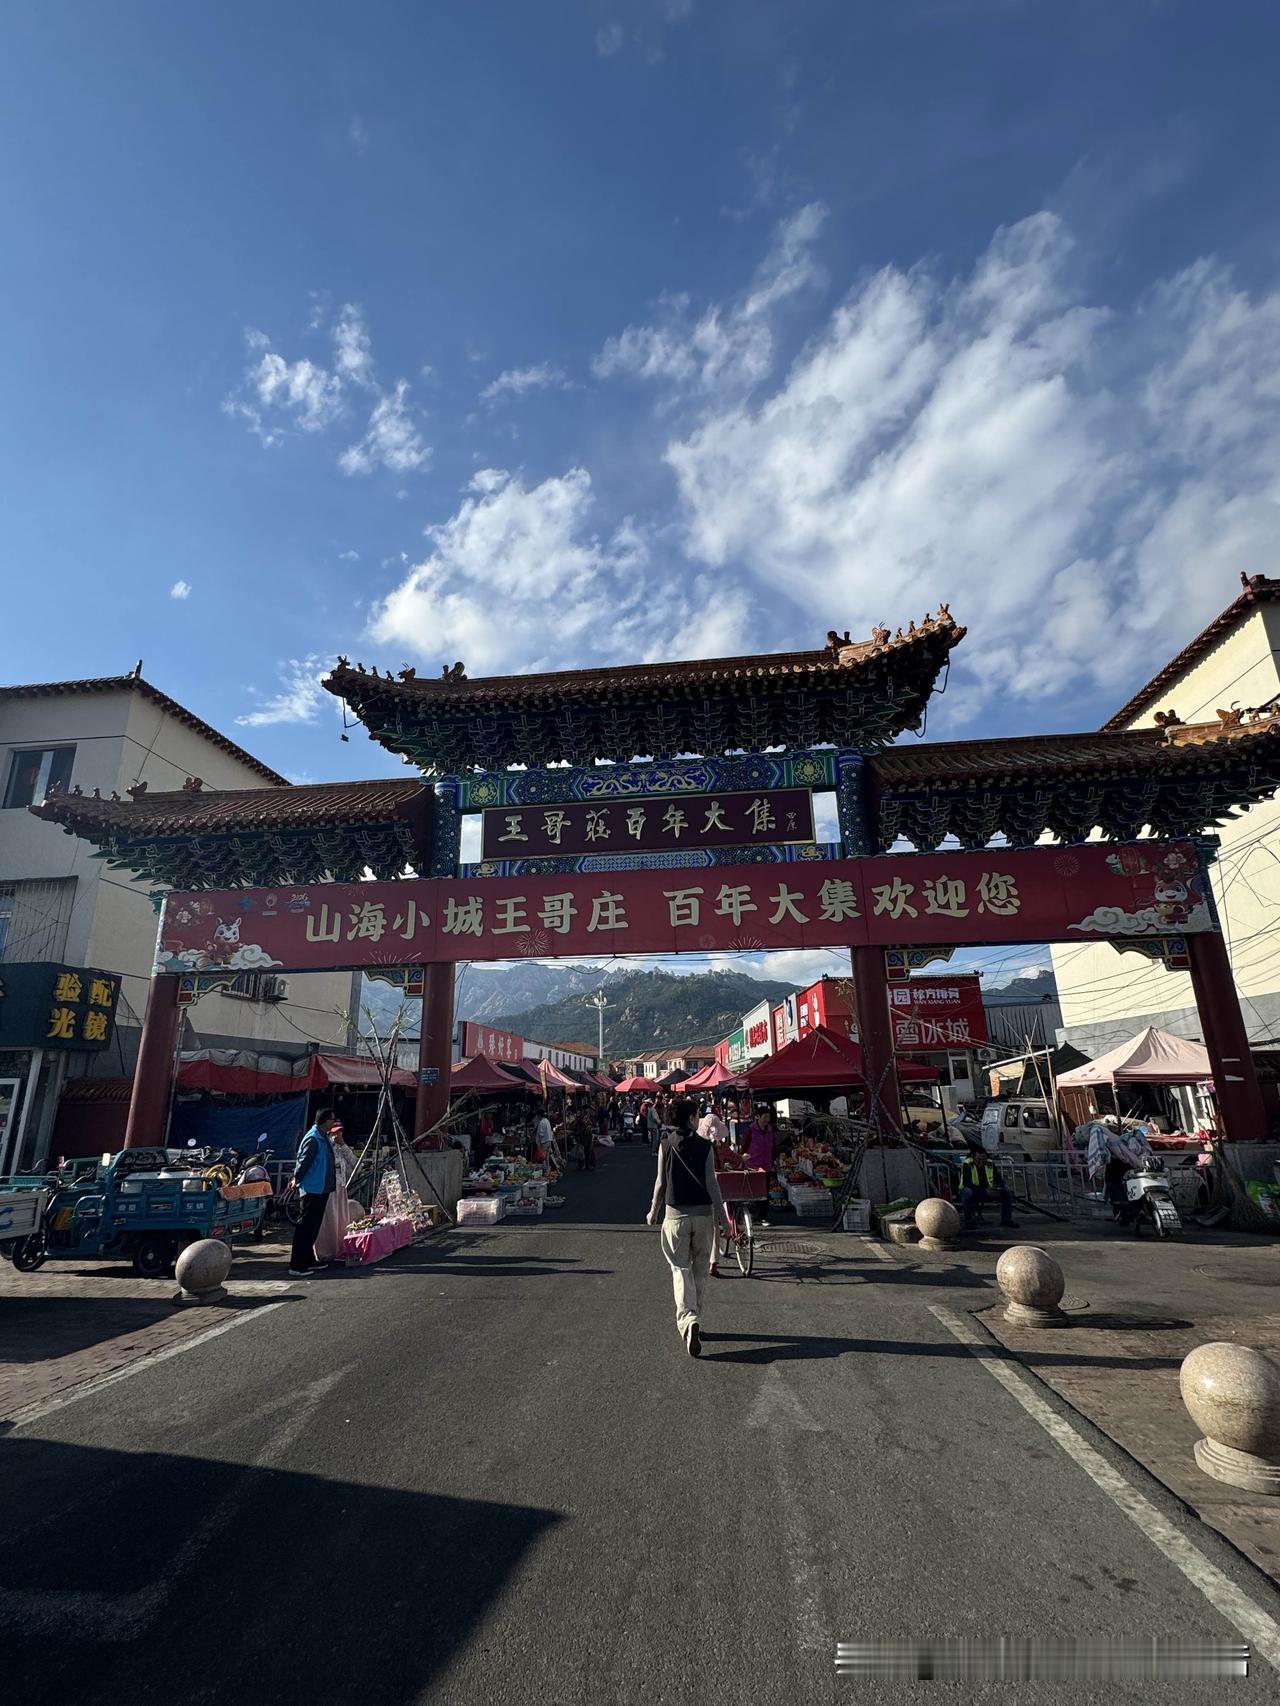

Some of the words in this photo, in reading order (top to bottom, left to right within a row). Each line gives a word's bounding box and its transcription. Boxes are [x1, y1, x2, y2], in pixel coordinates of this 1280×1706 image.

[306, 890, 629, 943] 山海小城王哥庄
[663, 872, 1021, 927] 百年大集欢迎您
